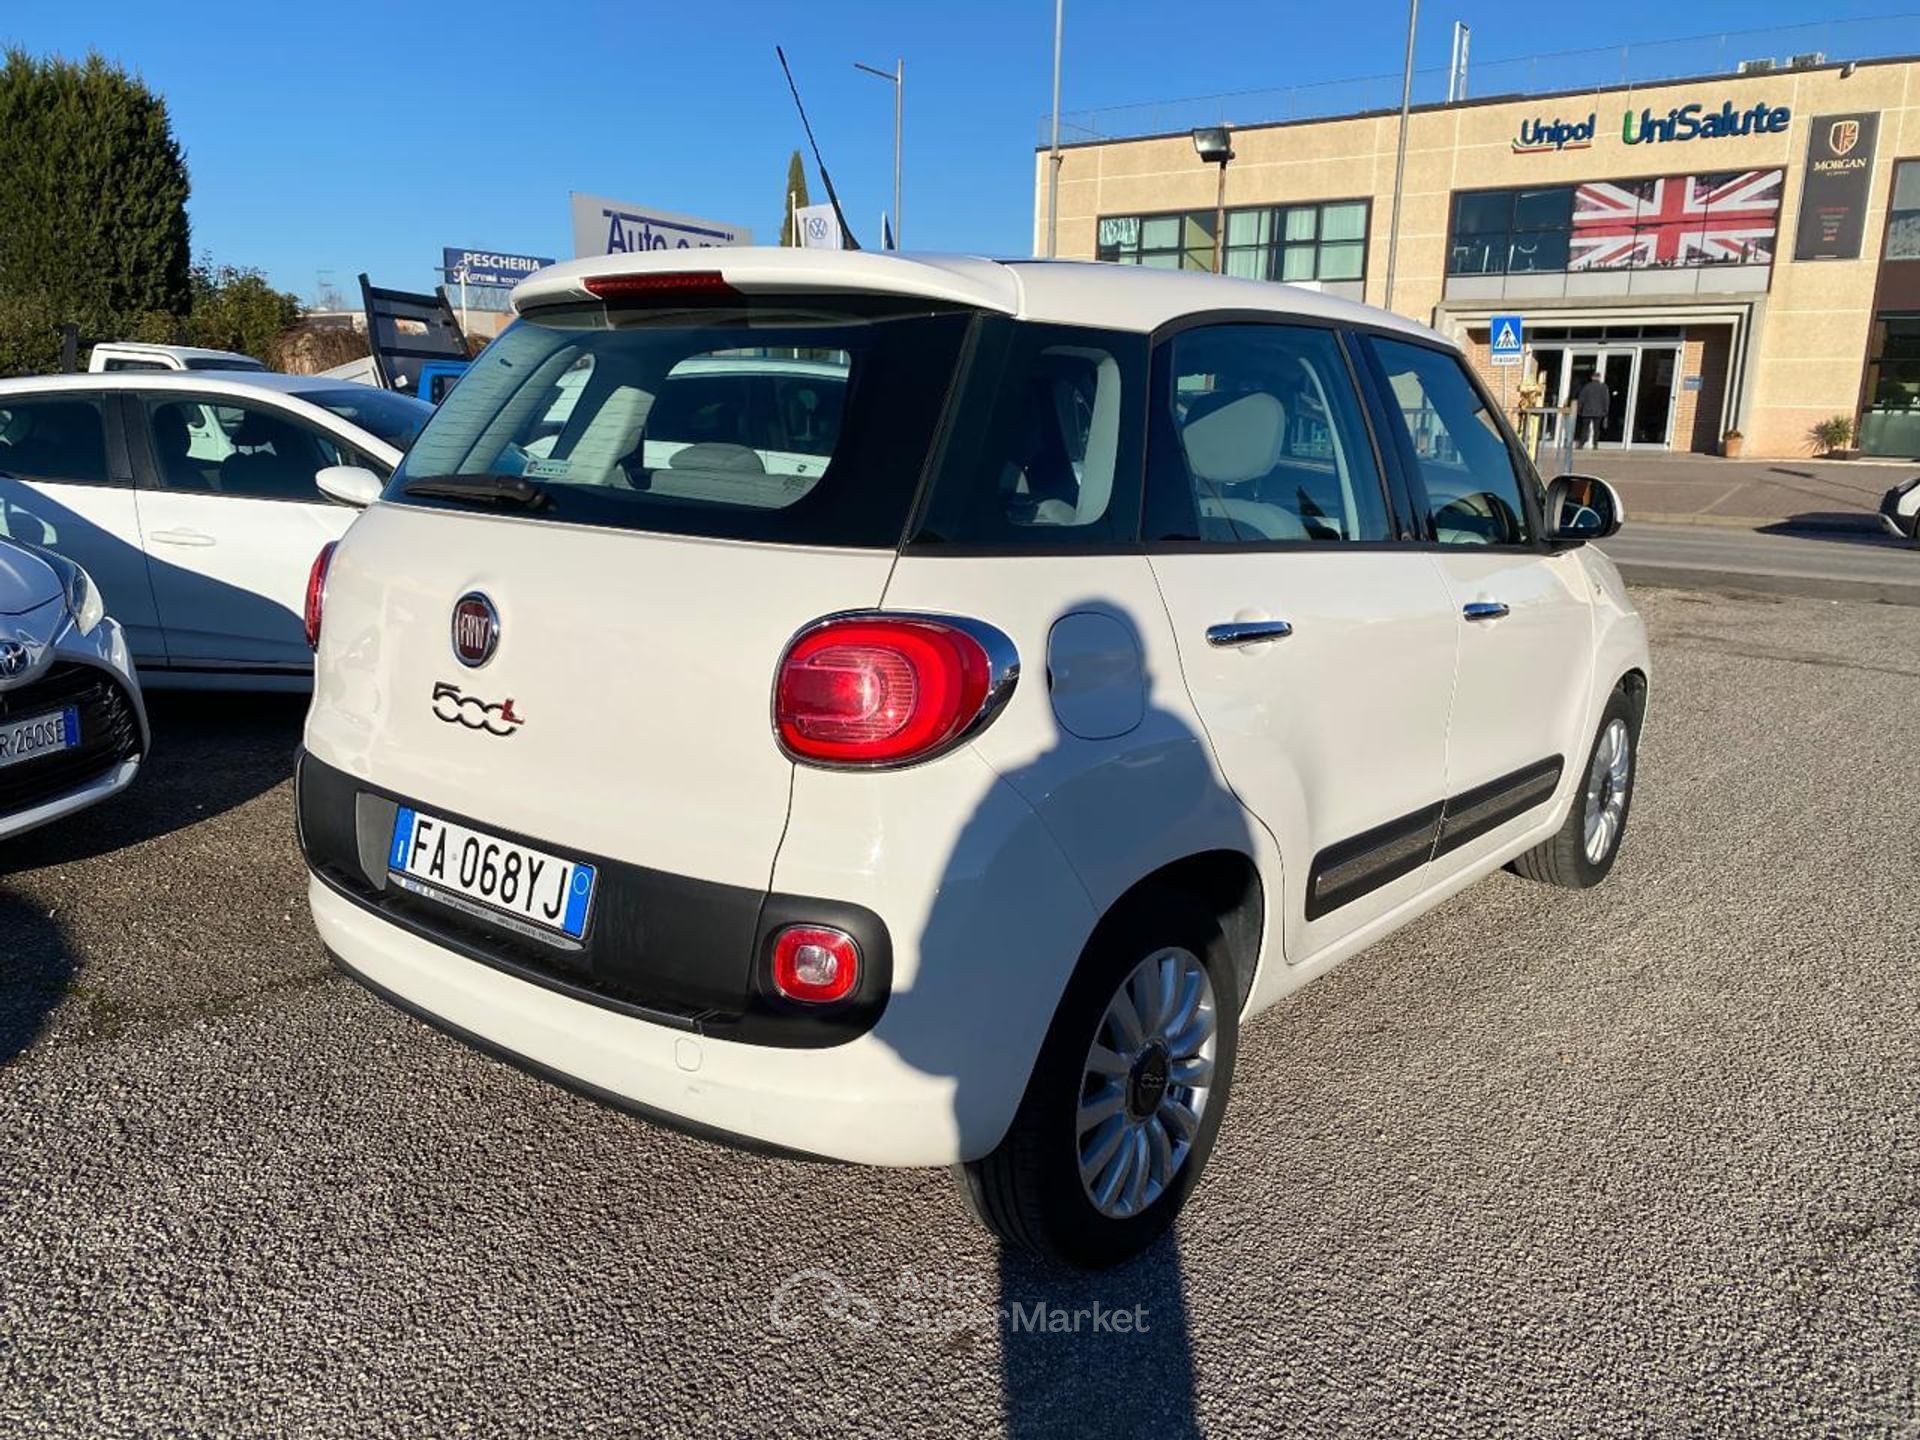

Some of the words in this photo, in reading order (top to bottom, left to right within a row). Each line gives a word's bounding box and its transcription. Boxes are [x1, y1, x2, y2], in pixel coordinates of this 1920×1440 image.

[1520, 112, 1596, 150] Unipol
[1622, 101, 1791, 145] UniSalute
[1814, 158, 1867, 171] MORGAN
[463, 252, 540, 271] PESCHERIA
[14, 719, 64, 754] 260SE
[409, 819, 447, 880] FA
[460, 836, 569, 919] 068YJ
